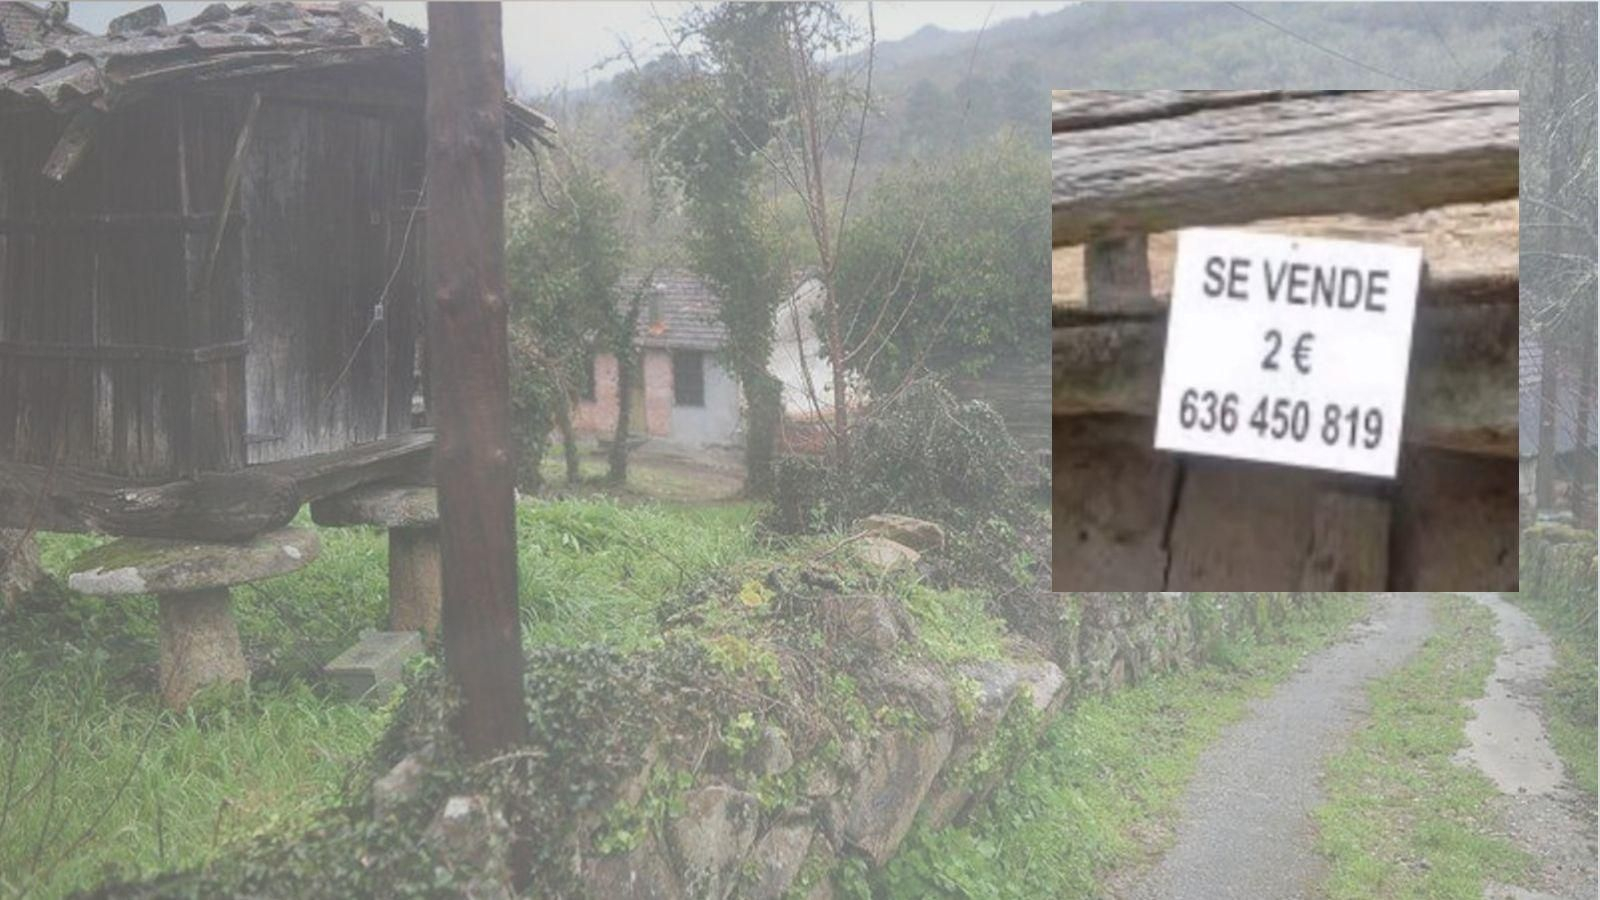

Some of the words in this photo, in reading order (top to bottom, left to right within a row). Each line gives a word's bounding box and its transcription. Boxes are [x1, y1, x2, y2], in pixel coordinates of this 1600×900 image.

[1203, 256, 1251, 300] SE
[1264, 260, 1389, 312] VENDE
[1261, 329, 1282, 371] 2
[1291, 332, 1315, 375] €
[1179, 388, 1239, 434] 636
[1249, 396, 1310, 442] 450
[1321, 403, 1384, 450] 819
